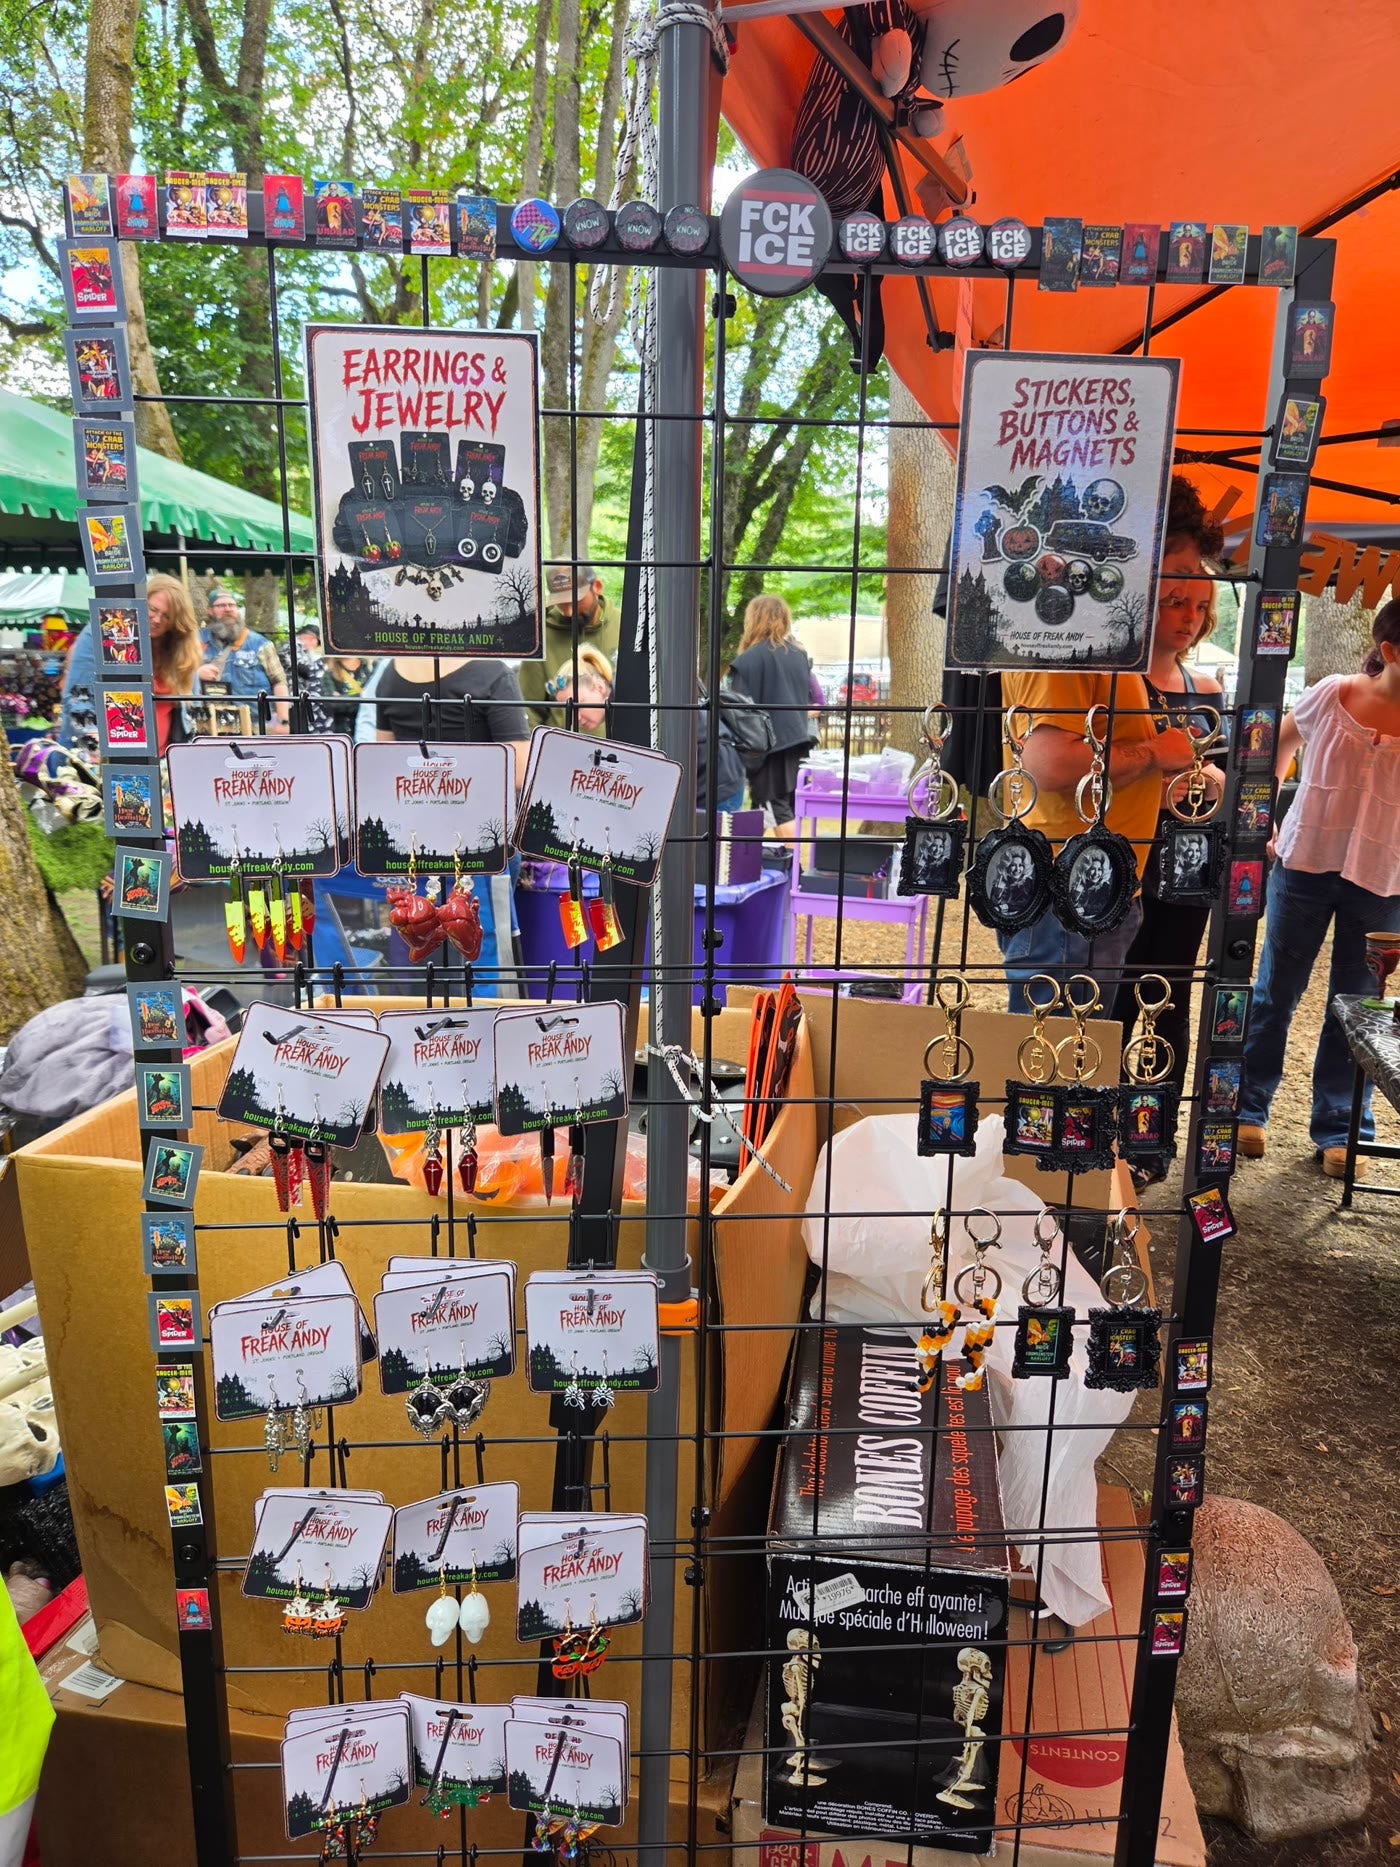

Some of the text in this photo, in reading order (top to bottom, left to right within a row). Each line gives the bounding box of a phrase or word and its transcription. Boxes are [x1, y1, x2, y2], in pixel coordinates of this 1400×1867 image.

[636, 205, 646, 213] NO
[740, 200, 817, 235] FCK
[575, 218, 600, 232] KNOW
[627, 223, 653, 235] KNOW
[676, 225, 701, 237] KNOW
[846, 223, 880, 237] FCK
[897, 225, 930, 240] FCK
[944, 226, 980, 244] FCK
[846, 237, 881, 252] ICE
[991, 228, 1025, 245] FCK
[738, 231, 815, 267] ICE
[897, 240, 932, 255] ICE
[945, 240, 981, 260] ICE
[991, 243, 1027, 260] ICE
[342, 347, 507, 392] EARRINGS &
[1012, 377, 1136, 409] STICKERS,
[351, 387, 507, 439] JEWELRY
[993, 407, 1140, 447] BUTTONS &
[1009, 437, 1137, 474] MAGNETS
[375, 632, 494, 645] HOUSE OF FREAK ANDY
[1010, 632, 1084, 642] HOUSE OF FREAK ANDY
[232, 770, 274, 778] HOUSE OF
[413, 769, 453, 778] HOUSE OF
[590, 767, 627, 782] HOUSE OF
[213, 776, 295, 806] FREAK ANDY
[396, 776, 472, 802] FREAK ANDY
[570, 769, 644, 809] FREAK ANDY
[296, 1039, 320, 1050] HOUSE
[429, 1034, 452, 1043] HOUSE
[542, 1031, 575, 1042] HOUSE OF
[274, 1042, 351, 1078] FREAK ANDY
[414, 1038, 481, 1067] FREAK ANDY
[528, 1035, 592, 1070] FREAK ANDY
[1061, 1137, 1086, 1147] SPIDER
[448, 1302, 478, 1323] ANDY
[560, 1310, 626, 1332] FREAK ANDY
[295, 1319, 309, 1330] OF
[240, 1325, 331, 1366] FREAK ANDY
[858, 1342, 922, 1426] COFFIN
[944, 1396, 965, 1411] est
[942, 1413, 973, 1464] squeletes
[854, 1435, 925, 1528] BONES
[945, 1466, 971, 1486] des
[310, 1516, 331, 1525] HOUSE
[427, 1509, 489, 1537] FREK ANDY
[326, 1525, 359, 1546] ANDY
[592, 1547, 604, 1557] OF
[543, 1552, 623, 1587] FREAK ANDY
[907, 1586, 983, 1613] effayante!
[839, 1608, 892, 1630] spéciale
[427, 1722, 485, 1744] FREK ANDY
[316, 1742, 379, 1774] FREK ANDY
[535, 1745, 594, 1767] FREK ANDY
[1030, 1744, 1120, 1762] CONTENTS
